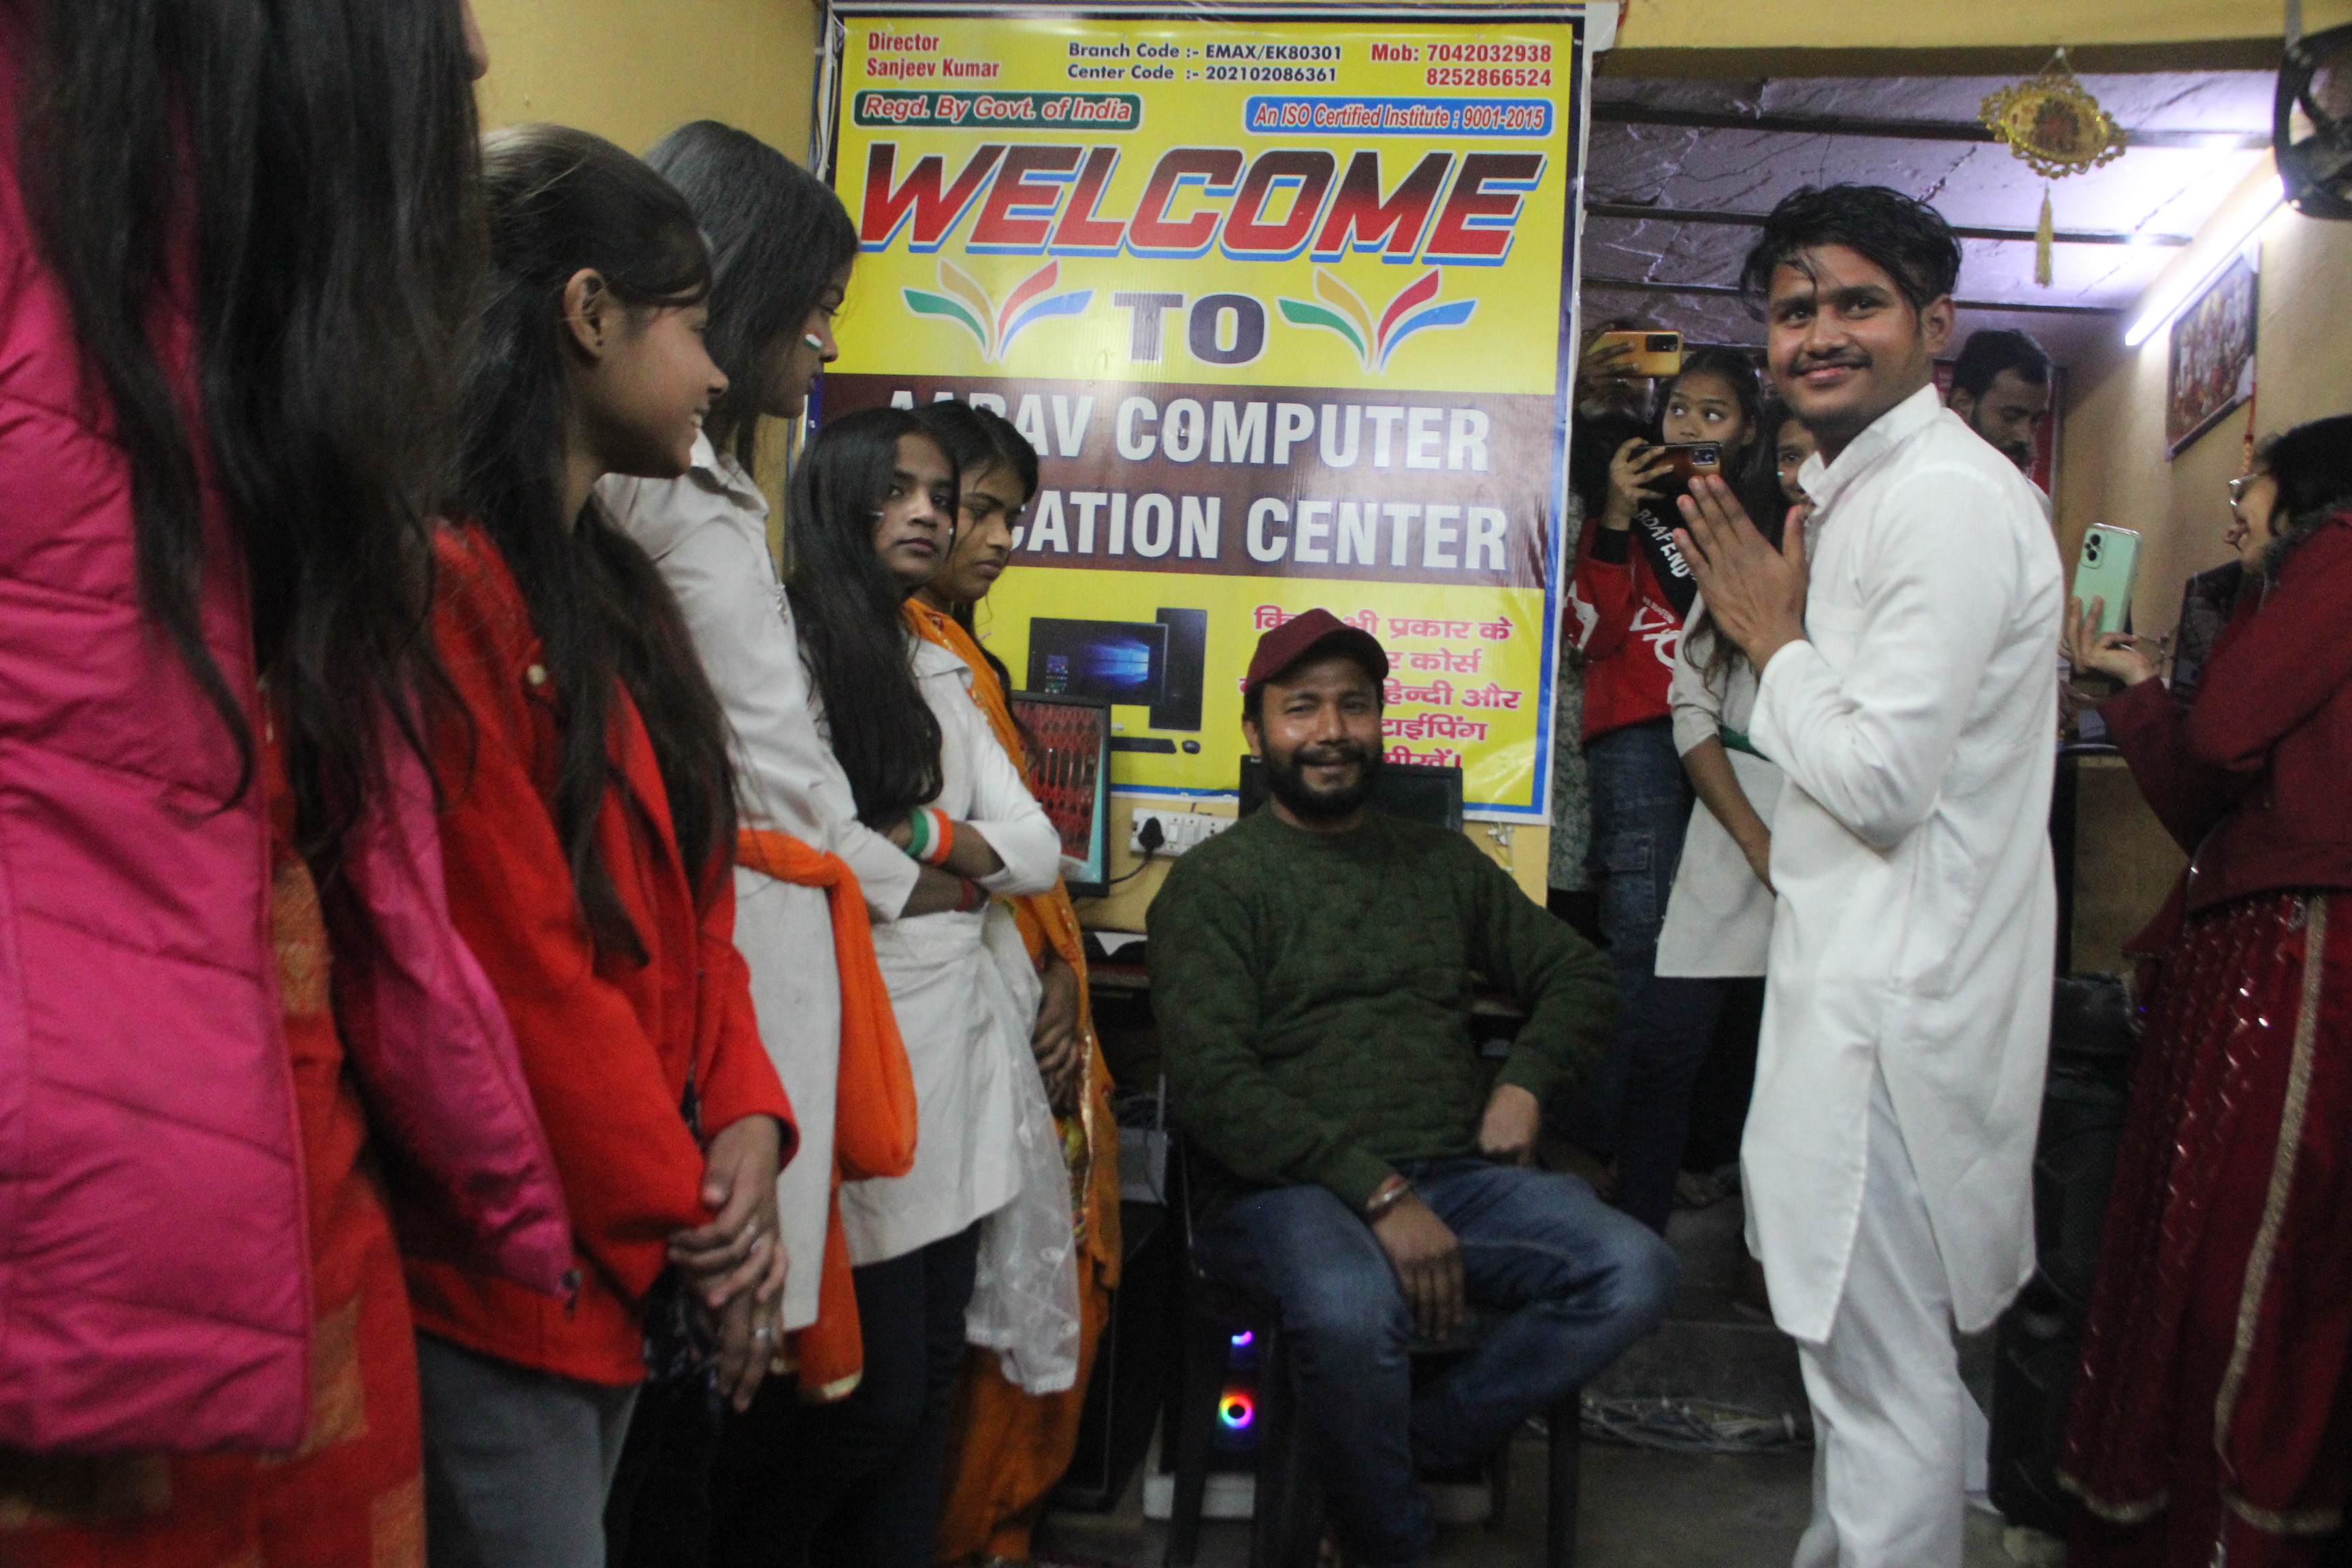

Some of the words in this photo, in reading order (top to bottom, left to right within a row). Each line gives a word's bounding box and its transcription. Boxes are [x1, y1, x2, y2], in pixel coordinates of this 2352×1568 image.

[868, 33, 939, 52] Director
[1068, 43, 1130, 59] Branch
[1137, 44, 1180, 59] Code
[1206, 44, 1341, 61] EMAX/EK80301
[1371, 44, 1419, 62] Mob:
[1426, 45, 1552, 63] 7042032938
[866, 57, 938, 80] Sanjeev
[943, 59, 1000, 78] Kumar
[1068, 64, 1126, 80] Center
[1131, 65, 1174, 80] Code
[1206, 66, 1337, 83] 202102086361
[1426, 69, 1552, 86] 8252866524
[863, 95, 930, 122] Regd.
[936, 97, 968, 122] By
[974, 97, 1035, 119] Govt.
[1043, 97, 1069, 119] of
[1073, 99, 1132, 121] India
[1254, 103, 1278, 125] An
[1281, 105, 1310, 126] ISO
[1314, 105, 1380, 127] Certified
[1384, 107, 1449, 128] Institute
[1463, 108, 1544, 129] 9001-2015
[859, 142, 1548, 266] WELCOME
[1113, 291, 1269, 368] TO
[1116, 397, 1490, 472] COMPUTER
[1246, 497, 1509, 571] CENTER
[1388, 617, 1473, 640] प्रकार
[1478, 616, 1514, 641] के
[1409, 647, 1482, 673] कोर्स
[1462, 682, 1522, 709] और
